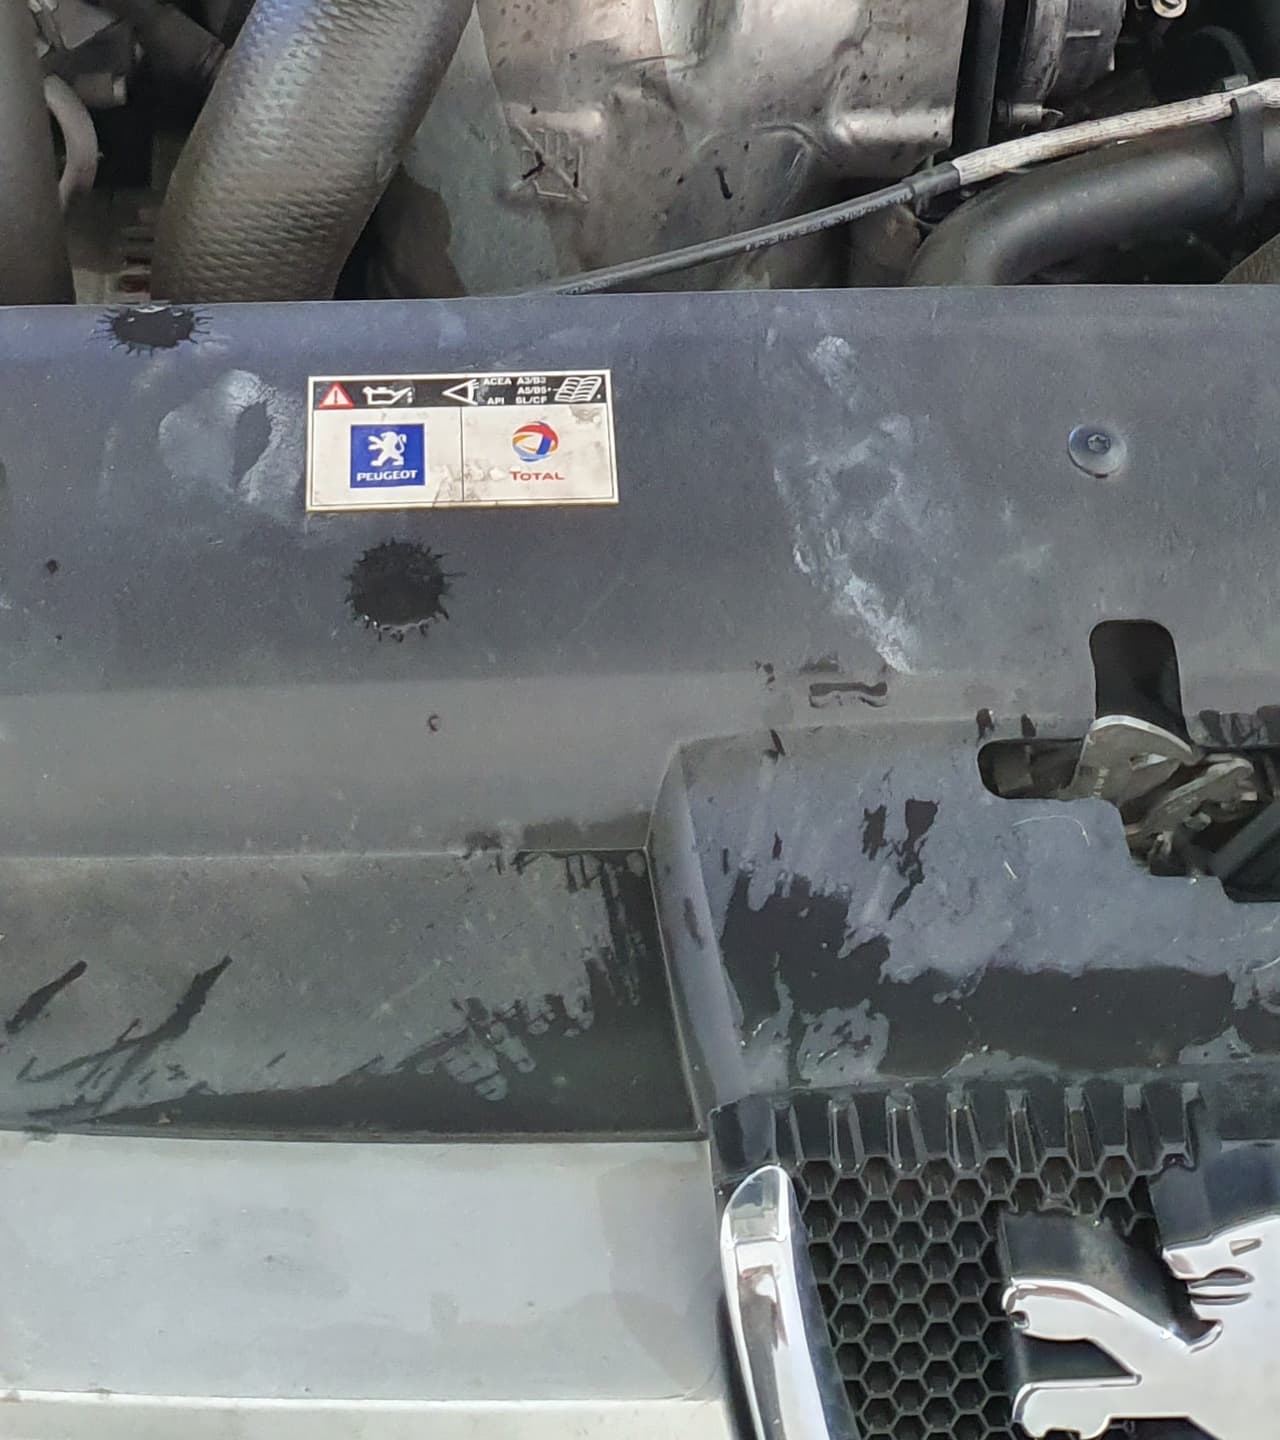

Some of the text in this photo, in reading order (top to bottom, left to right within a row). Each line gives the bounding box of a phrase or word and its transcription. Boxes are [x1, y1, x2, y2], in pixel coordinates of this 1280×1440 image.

[483, 377, 512, 386] ACEA
[486, 396, 505, 406] API
[356, 469, 418, 482] PEUGEOT
[509, 470, 566, 481] TOTAL
